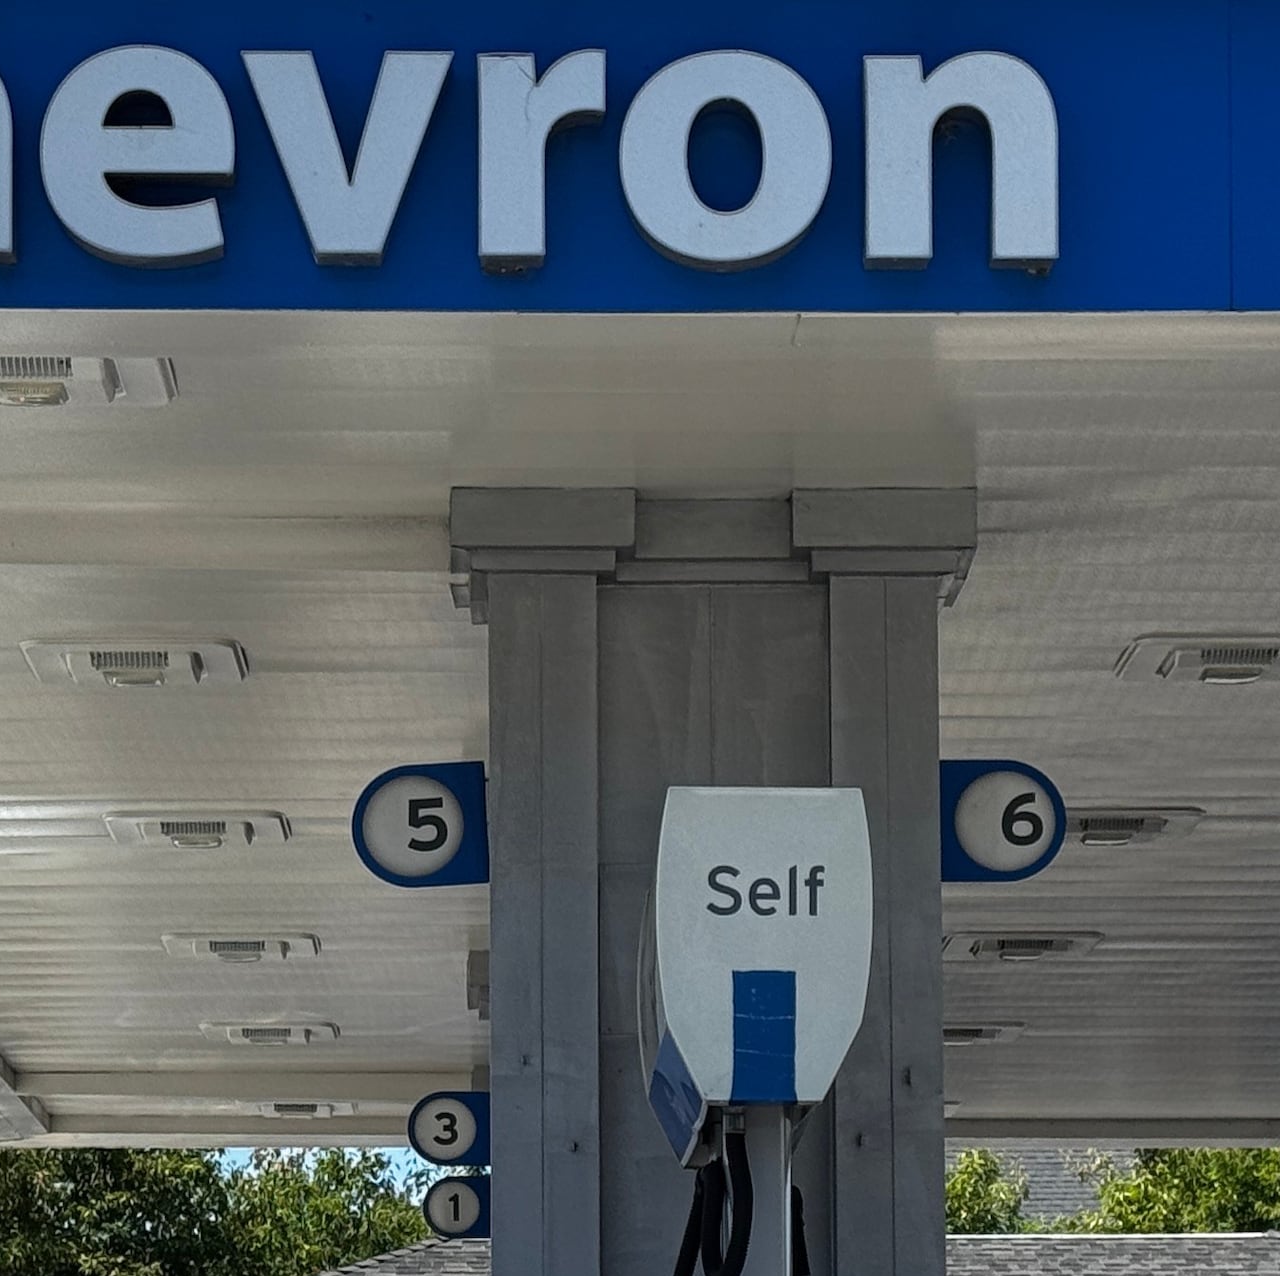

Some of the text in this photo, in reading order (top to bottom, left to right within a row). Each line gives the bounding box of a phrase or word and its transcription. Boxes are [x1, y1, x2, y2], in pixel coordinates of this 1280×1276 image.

[407, 797, 448, 851] 5
[1001, 793, 1044, 846] 6
[706, 865, 825, 917] Self
[433, 1112, 458, 1145] 3
[447, 1193, 461, 1222] 1
